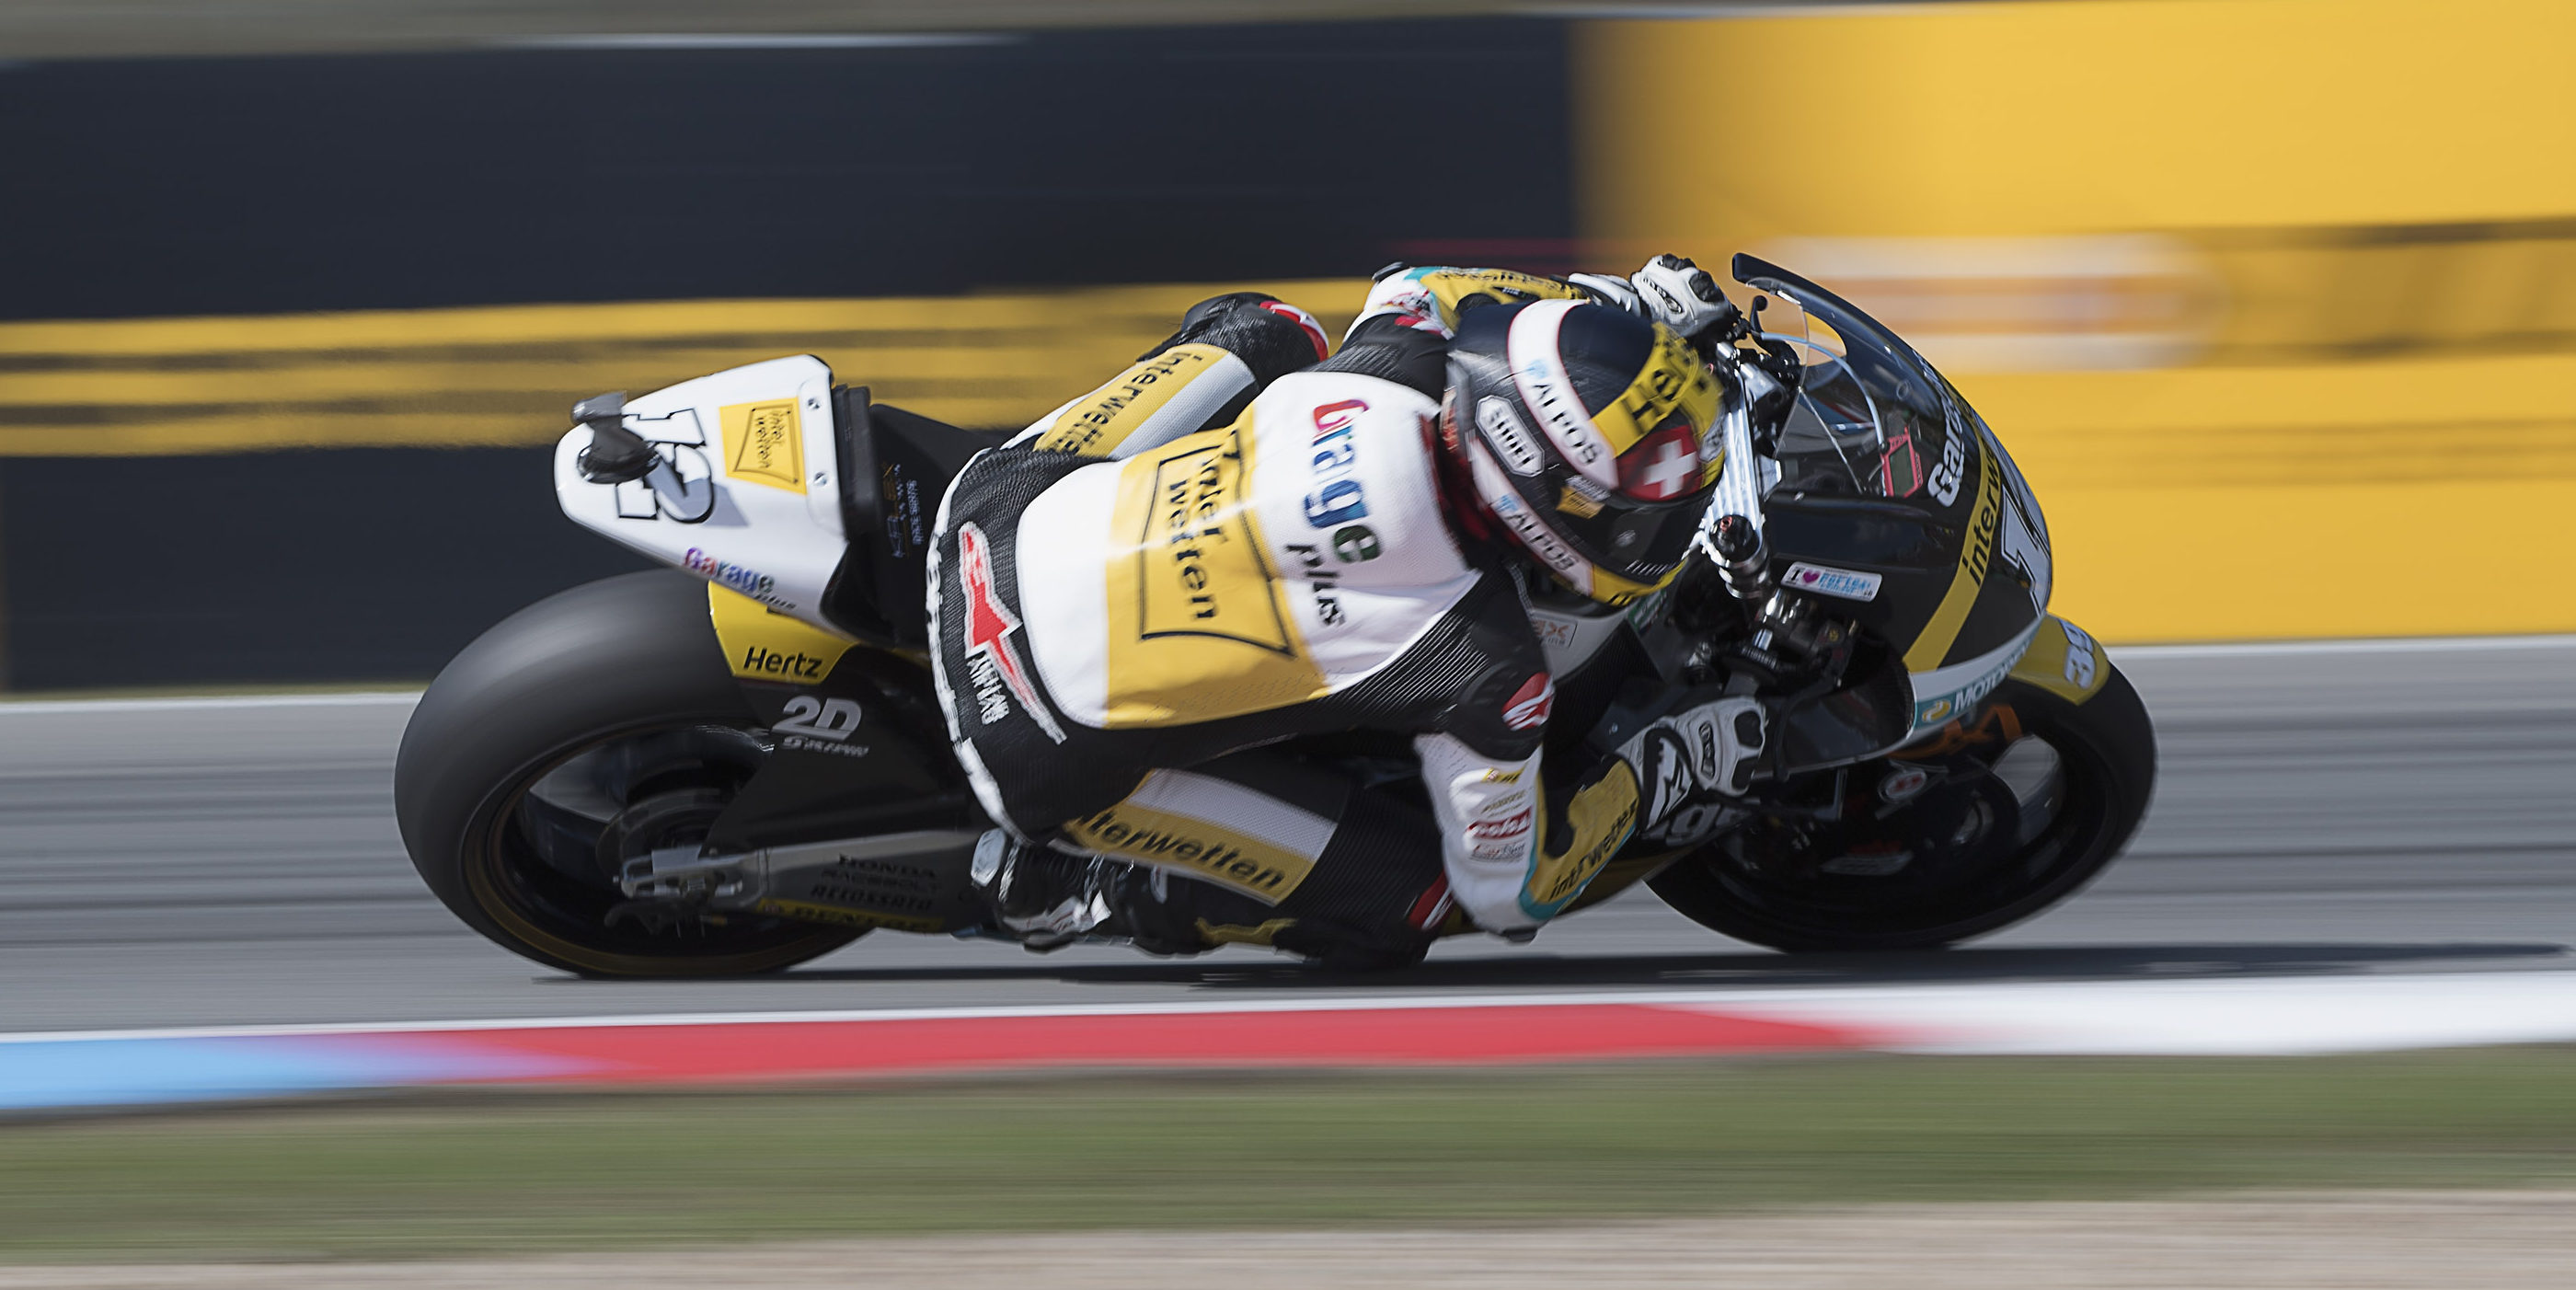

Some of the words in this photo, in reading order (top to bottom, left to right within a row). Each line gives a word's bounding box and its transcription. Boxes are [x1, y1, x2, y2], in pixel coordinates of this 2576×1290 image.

[684, 547, 775, 593] Garage
[1167, 479, 1220, 620] wetten
[743, 646, 822, 678] Hertz
[771, 696, 862, 741] 2D
[839, 853, 937, 878] HONDA
